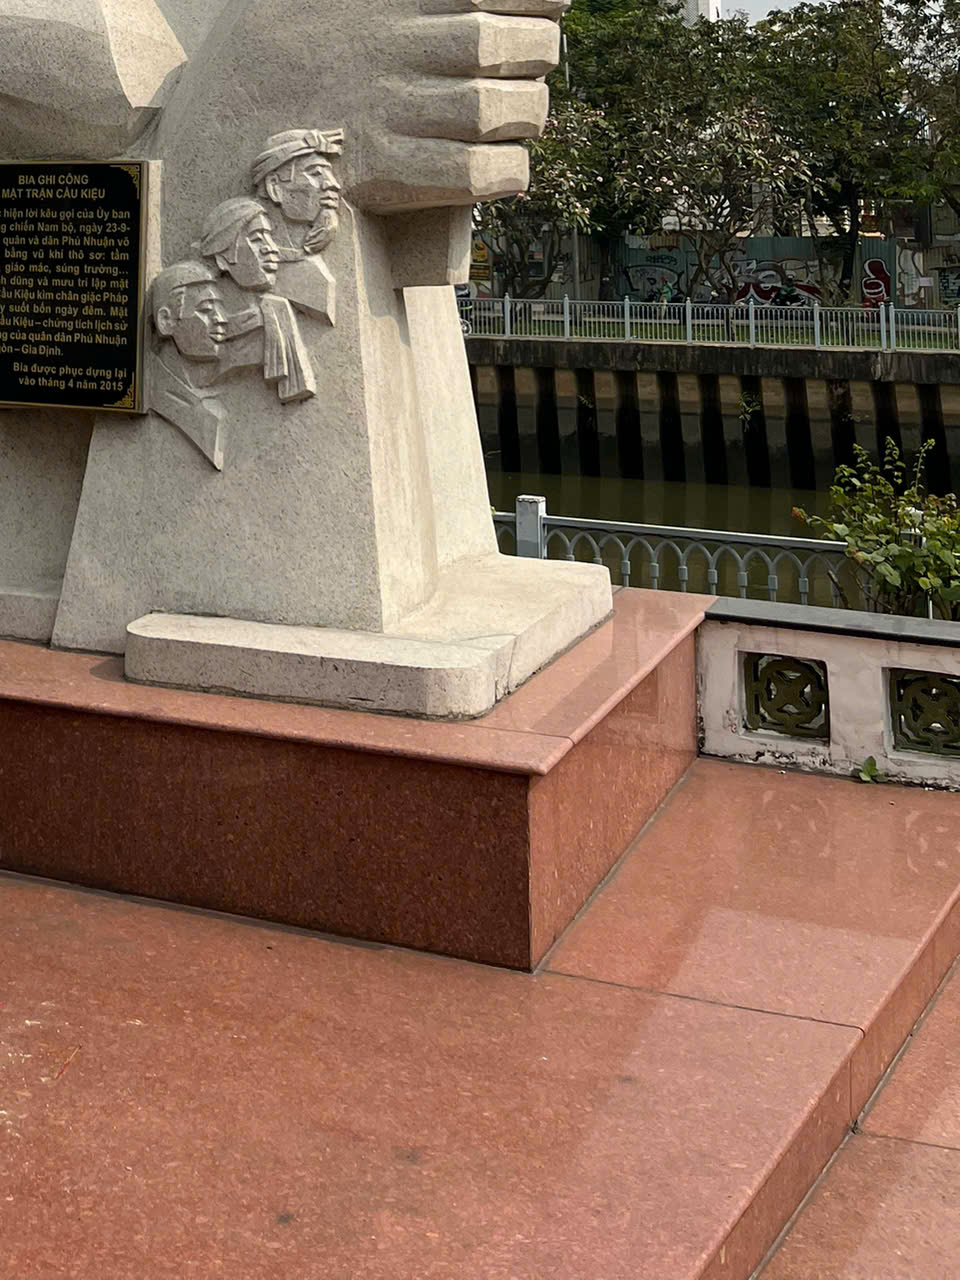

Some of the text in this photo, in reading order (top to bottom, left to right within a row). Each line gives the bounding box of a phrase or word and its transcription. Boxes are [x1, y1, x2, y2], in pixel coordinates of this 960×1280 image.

[18, 173, 88, 185] BIA GHI CÔNG
[2, 186, 105, 201] MẶT TRẬN CẦU KIỆU
[4, 208, 23, 220] hiện
[26, 209, 38, 218] lời
[40, 208, 57, 218] kêu
[59, 209, 74, 221] gọi
[77, 208, 94, 218] của
[97, 208, 109, 221] Ủy
[112, 209, 130, 219] ban
[9, 219, 34, 231] chiến
[37, 222, 58, 231] Nam
[62, 222, 76, 234] bộ,
[79, 222, 103, 235] ngày
[3, 235, 26, 247] quân
[28, 235, 39, 245] và
[42, 235, 59, 245] dân
[62, 236, 81, 246] Phú
[83, 236, 115, 248] Nhuận
[49, 249, 63, 259] khí
[5, 262, 25, 274] giáo
[56, 263, 80, 275] súng
[10, 276, 34, 288] dũng
[37, 276, 48, 286] và
[52, 279, 74, 287] mưu
[78, 278, 88, 287] trí
[91, 278, 106, 290] lập
[110, 279, 128, 290] mặt
[14, 289, 35, 301] Kiệu
[55, 290, 79, 301] chân
[80, 291, 101, 304] giặc
[103, 292, 128, 304] Pháp
[9, 301, 30, 313] suốt
[33, 303, 51, 313] bốn
[55, 304, 79, 317] ngày
[110, 306, 128, 319] Mặt
[13, 316, 34, 328] Kiệu
[42, 318, 74, 331] chứng
[75, 319, 93, 329] tích
[95, 320, 113, 332] lịch
[10, 330, 27, 340] của
[28, 331, 52, 342] quân
[54, 332, 72, 342] dân
[74, 333, 93, 343] Phú
[95, 334, 127, 346] Nhuận
[21, 344, 37, 354] Gia
[39, 345, 63, 357] Định.
[13, 362, 127, 379] Bia được phục dựng lại
[19, 376, 123, 391] vào tháng 4 năm 2015
